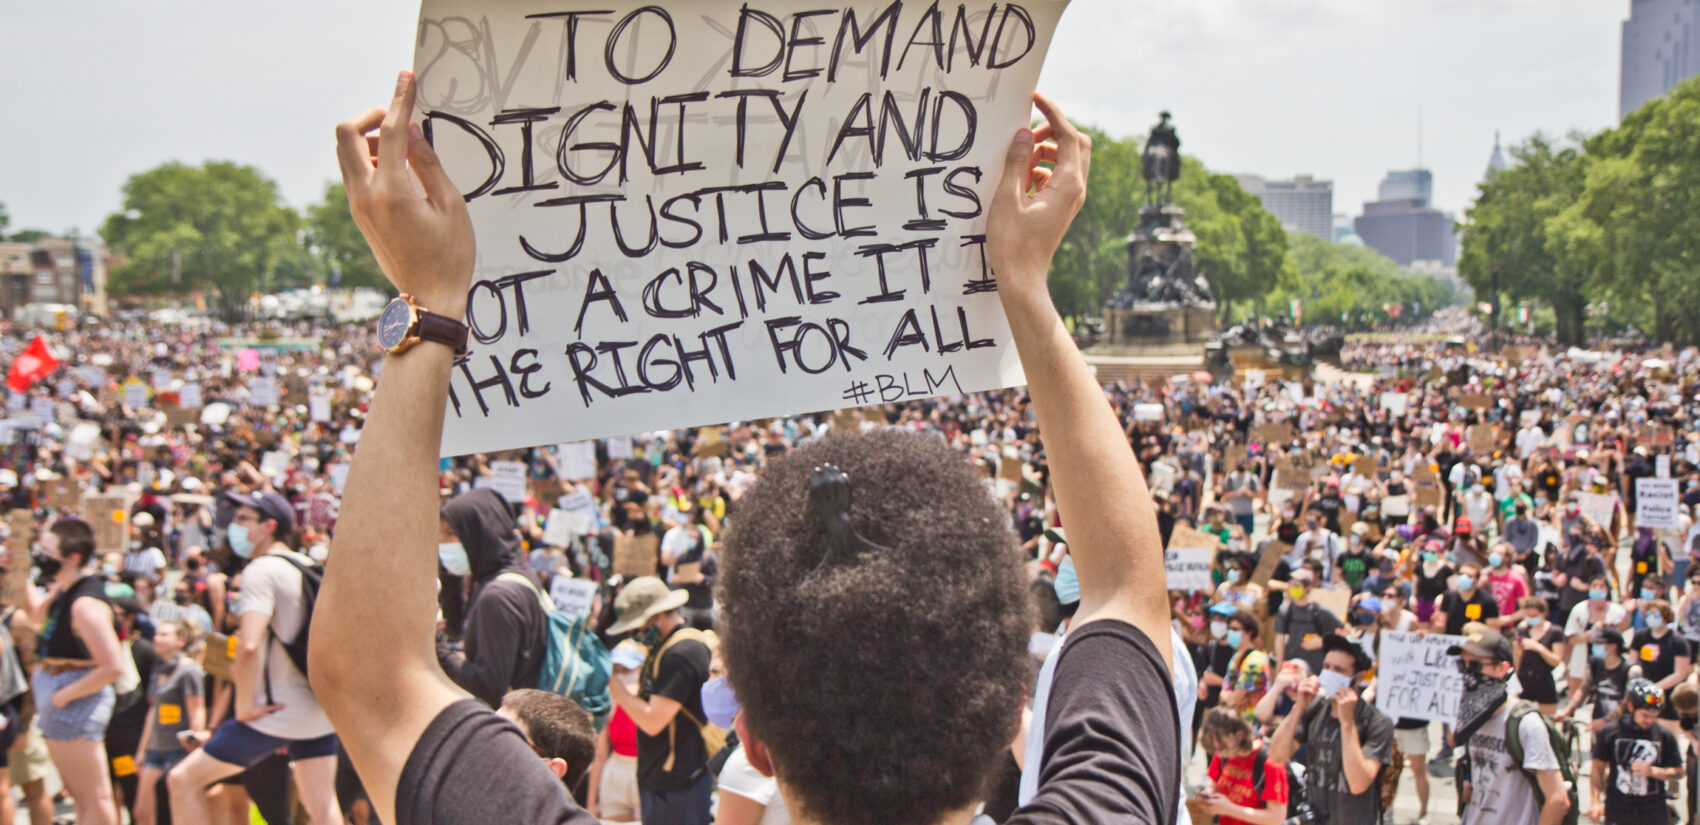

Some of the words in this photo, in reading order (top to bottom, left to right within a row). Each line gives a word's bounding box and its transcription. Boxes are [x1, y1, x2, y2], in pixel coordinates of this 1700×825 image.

[525, 6, 676, 84] TO
[727, 1, 1036, 83] DEMAND
[422, 88, 809, 203] DIGNITY
[826, 86, 978, 168] AND
[519, 171, 878, 263] JUSTICE
[902, 166, 983, 231] IS
[465, 269, 557, 343] OT
[575, 268, 629, 340] A
[642, 251, 841, 320] CRIME
[853, 237, 940, 305] IT
[960, 233, 999, 296] I
[565, 322, 745, 408] RIGHT
[763, 315, 868, 375] FOR
[882, 303, 997, 361] ALL
[843, 364, 964, 408] #BLM
[1386, 684, 1421, 712] FOR
[1427, 691, 1459, 718] ALL
[1407, 669, 1461, 693] JUSTICE
